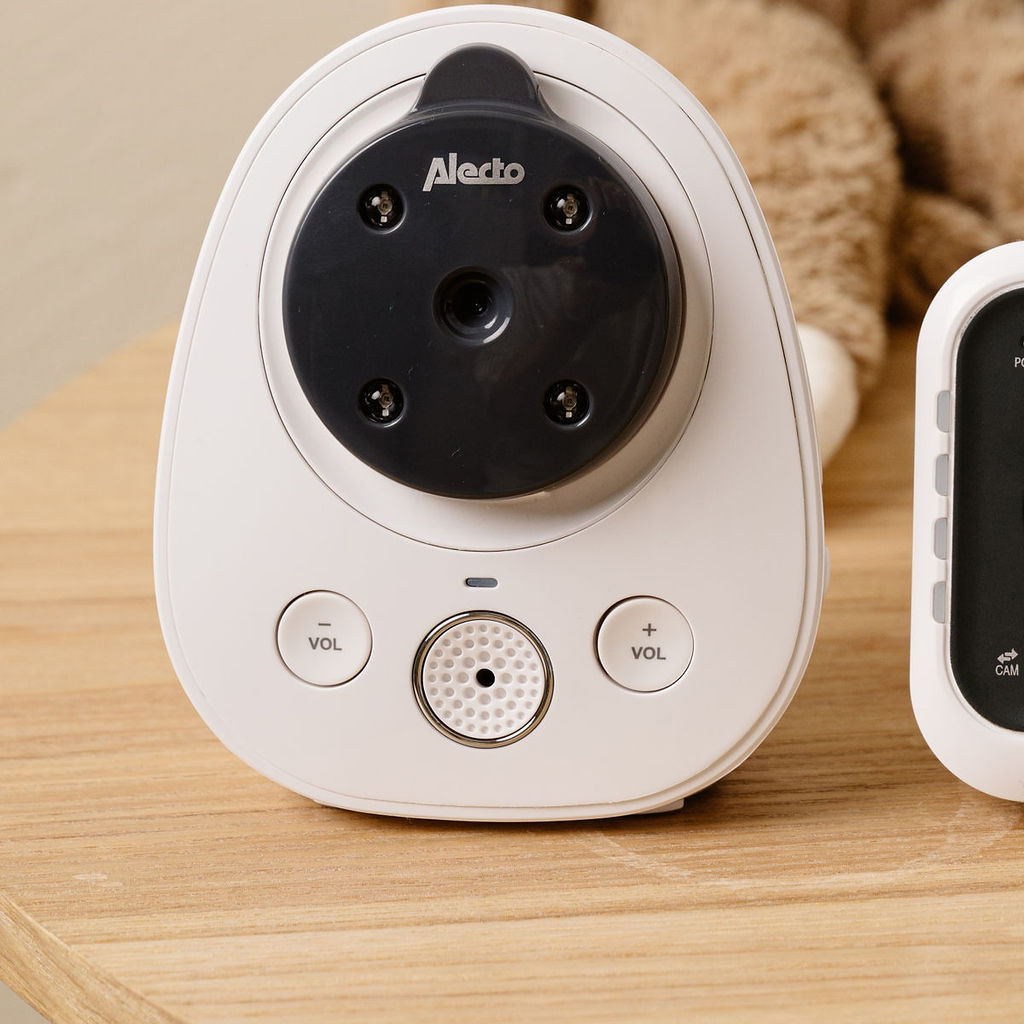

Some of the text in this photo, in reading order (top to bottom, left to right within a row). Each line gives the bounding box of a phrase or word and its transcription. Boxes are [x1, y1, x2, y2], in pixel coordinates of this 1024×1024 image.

[422, 152, 525, 192] Alecto
[308, 637, 343, 651] VOL
[631, 646, 667, 661] VOL
[995, 663, 1019, 676] CAM
